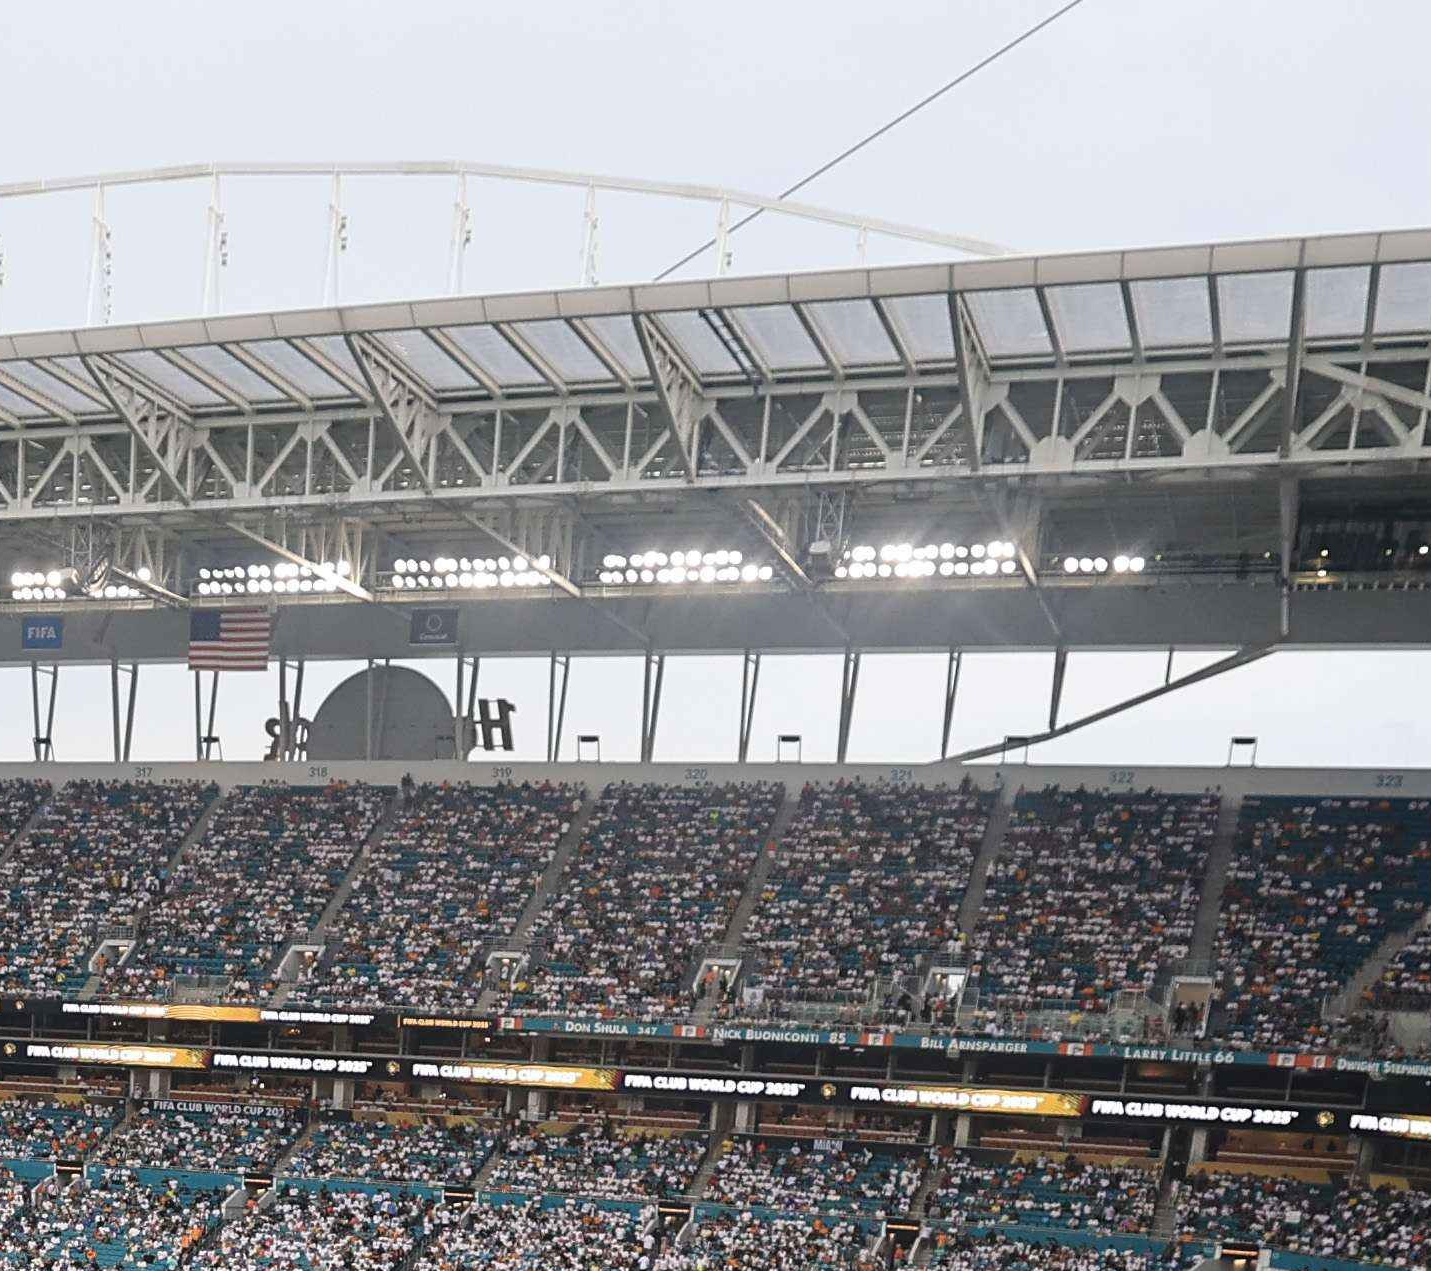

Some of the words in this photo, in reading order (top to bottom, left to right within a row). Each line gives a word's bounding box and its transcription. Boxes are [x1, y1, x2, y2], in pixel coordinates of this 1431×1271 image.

[28, 627, 57, 640] FIFA
[685, 769, 708, 780] 320
[565, 1021, 584, 1032] DON
[594, 1022, 628, 1034] SHULA
[638, 1025, 657, 1035] 347
[712, 1028, 741, 1041] NICK
[746, 1029, 819, 1043] BUONICONTI
[829, 1032, 846, 1044] 85
[921, 1037, 944, 1049] BILL
[947, 1038, 1027, 1053] ARNSPARGER
[1124, 1047, 1166, 1060] LARRY
[1171, 1049, 1211, 1063] LITTLE
[1214, 1051, 1234, 1063] 66
[1124, 1102, 1165, 1117] CLUB
[1165, 1104, 1220, 1120] WORLD
[1219, 1107, 1253, 1122] CUP
